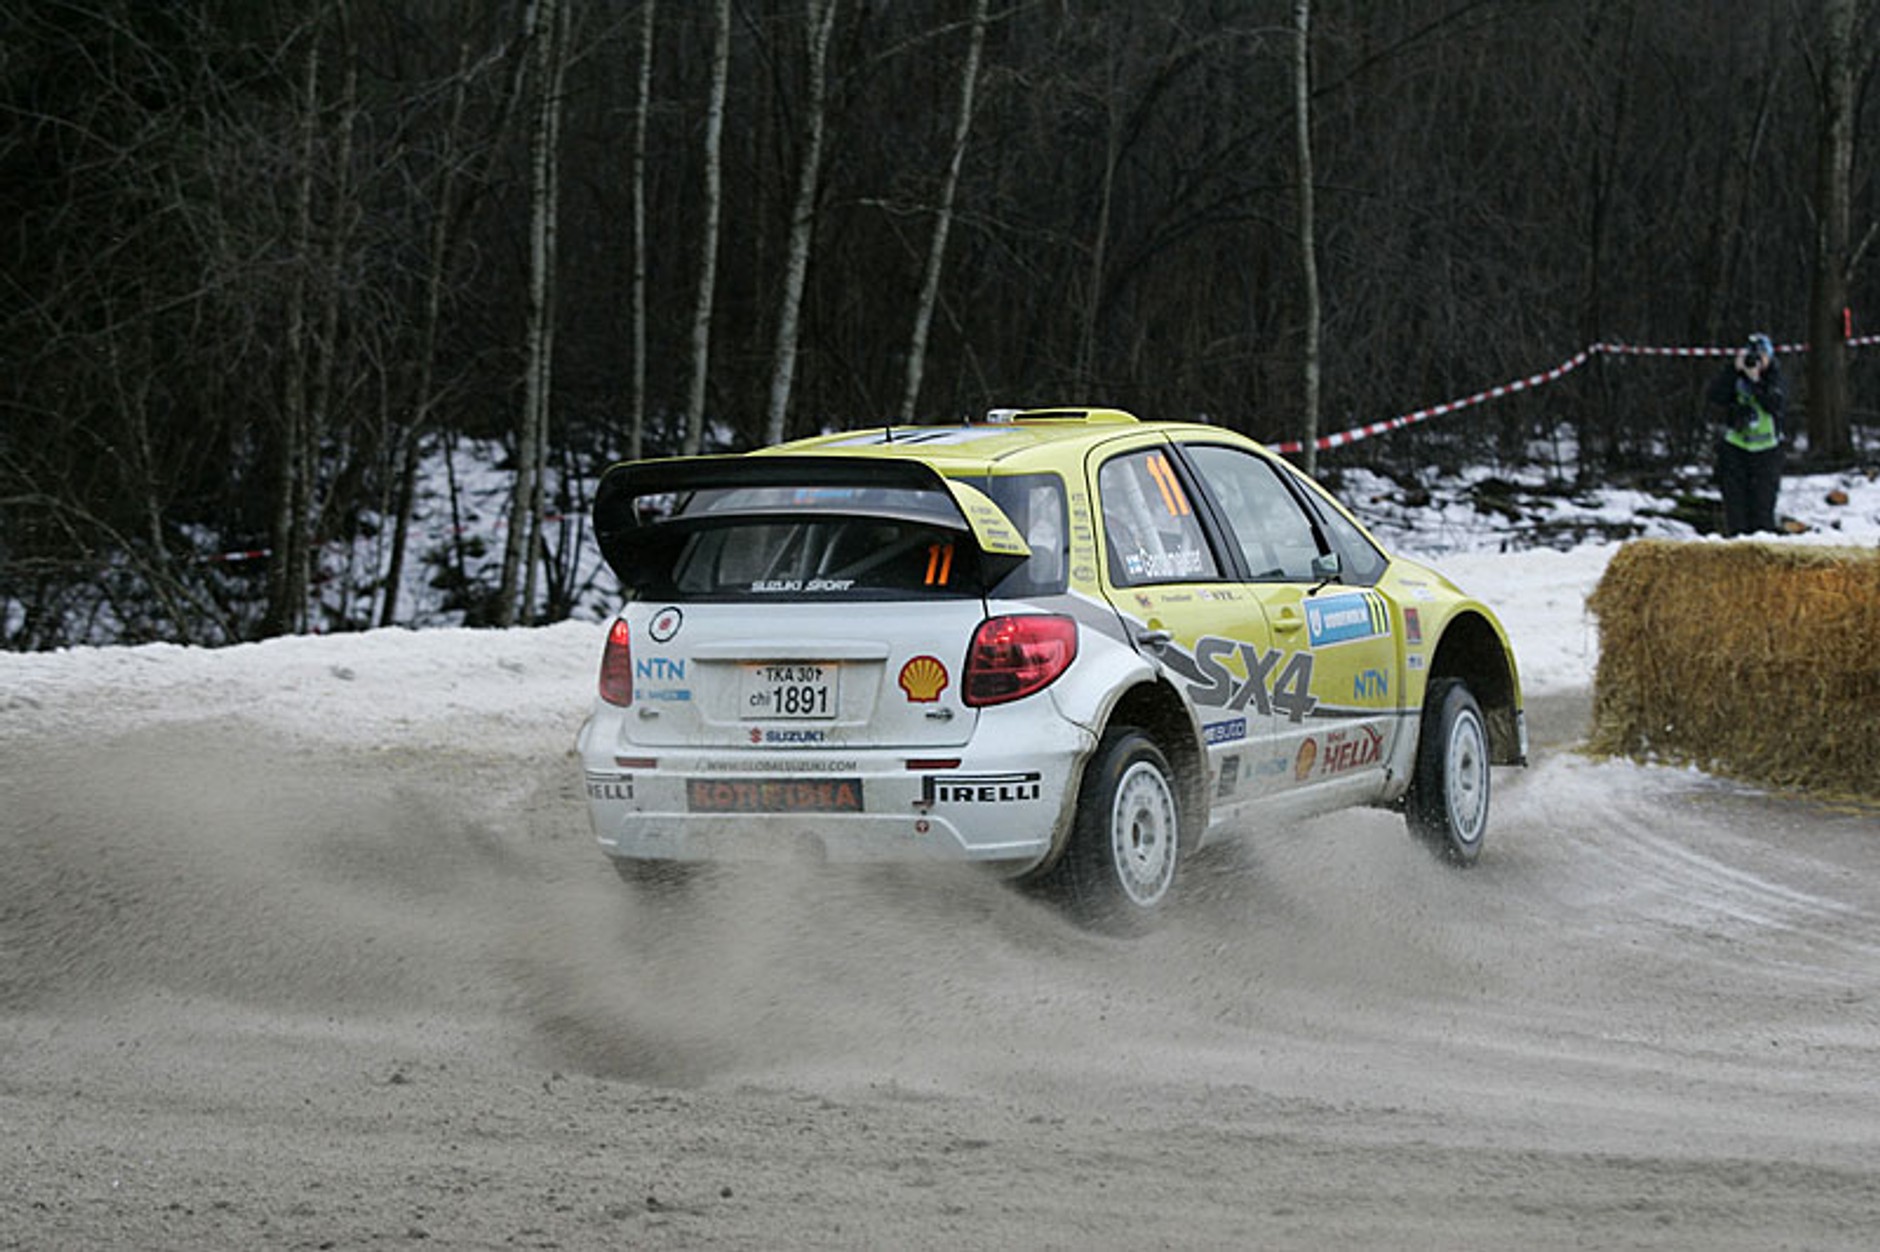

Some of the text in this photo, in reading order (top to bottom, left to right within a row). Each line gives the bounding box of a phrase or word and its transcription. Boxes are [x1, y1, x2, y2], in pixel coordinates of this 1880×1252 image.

[1146, 455, 1190, 517] 11
[925, 544, 954, 586] 11
[751, 579, 855, 593] SUZUKI SPORT
[1364, 592, 1388, 635] 11
[636, 657, 685, 680] NTN
[765, 667, 795, 682] TKA
[1187, 636, 1318, 724] SX4
[1353, 668, 1389, 700] NTN
[773, 685, 828, 715] 1891
[765, 730, 825, 743] SUZUKI
[1321, 726, 1384, 774] HELIX
[921, 771, 1042, 808] PIRELLI
